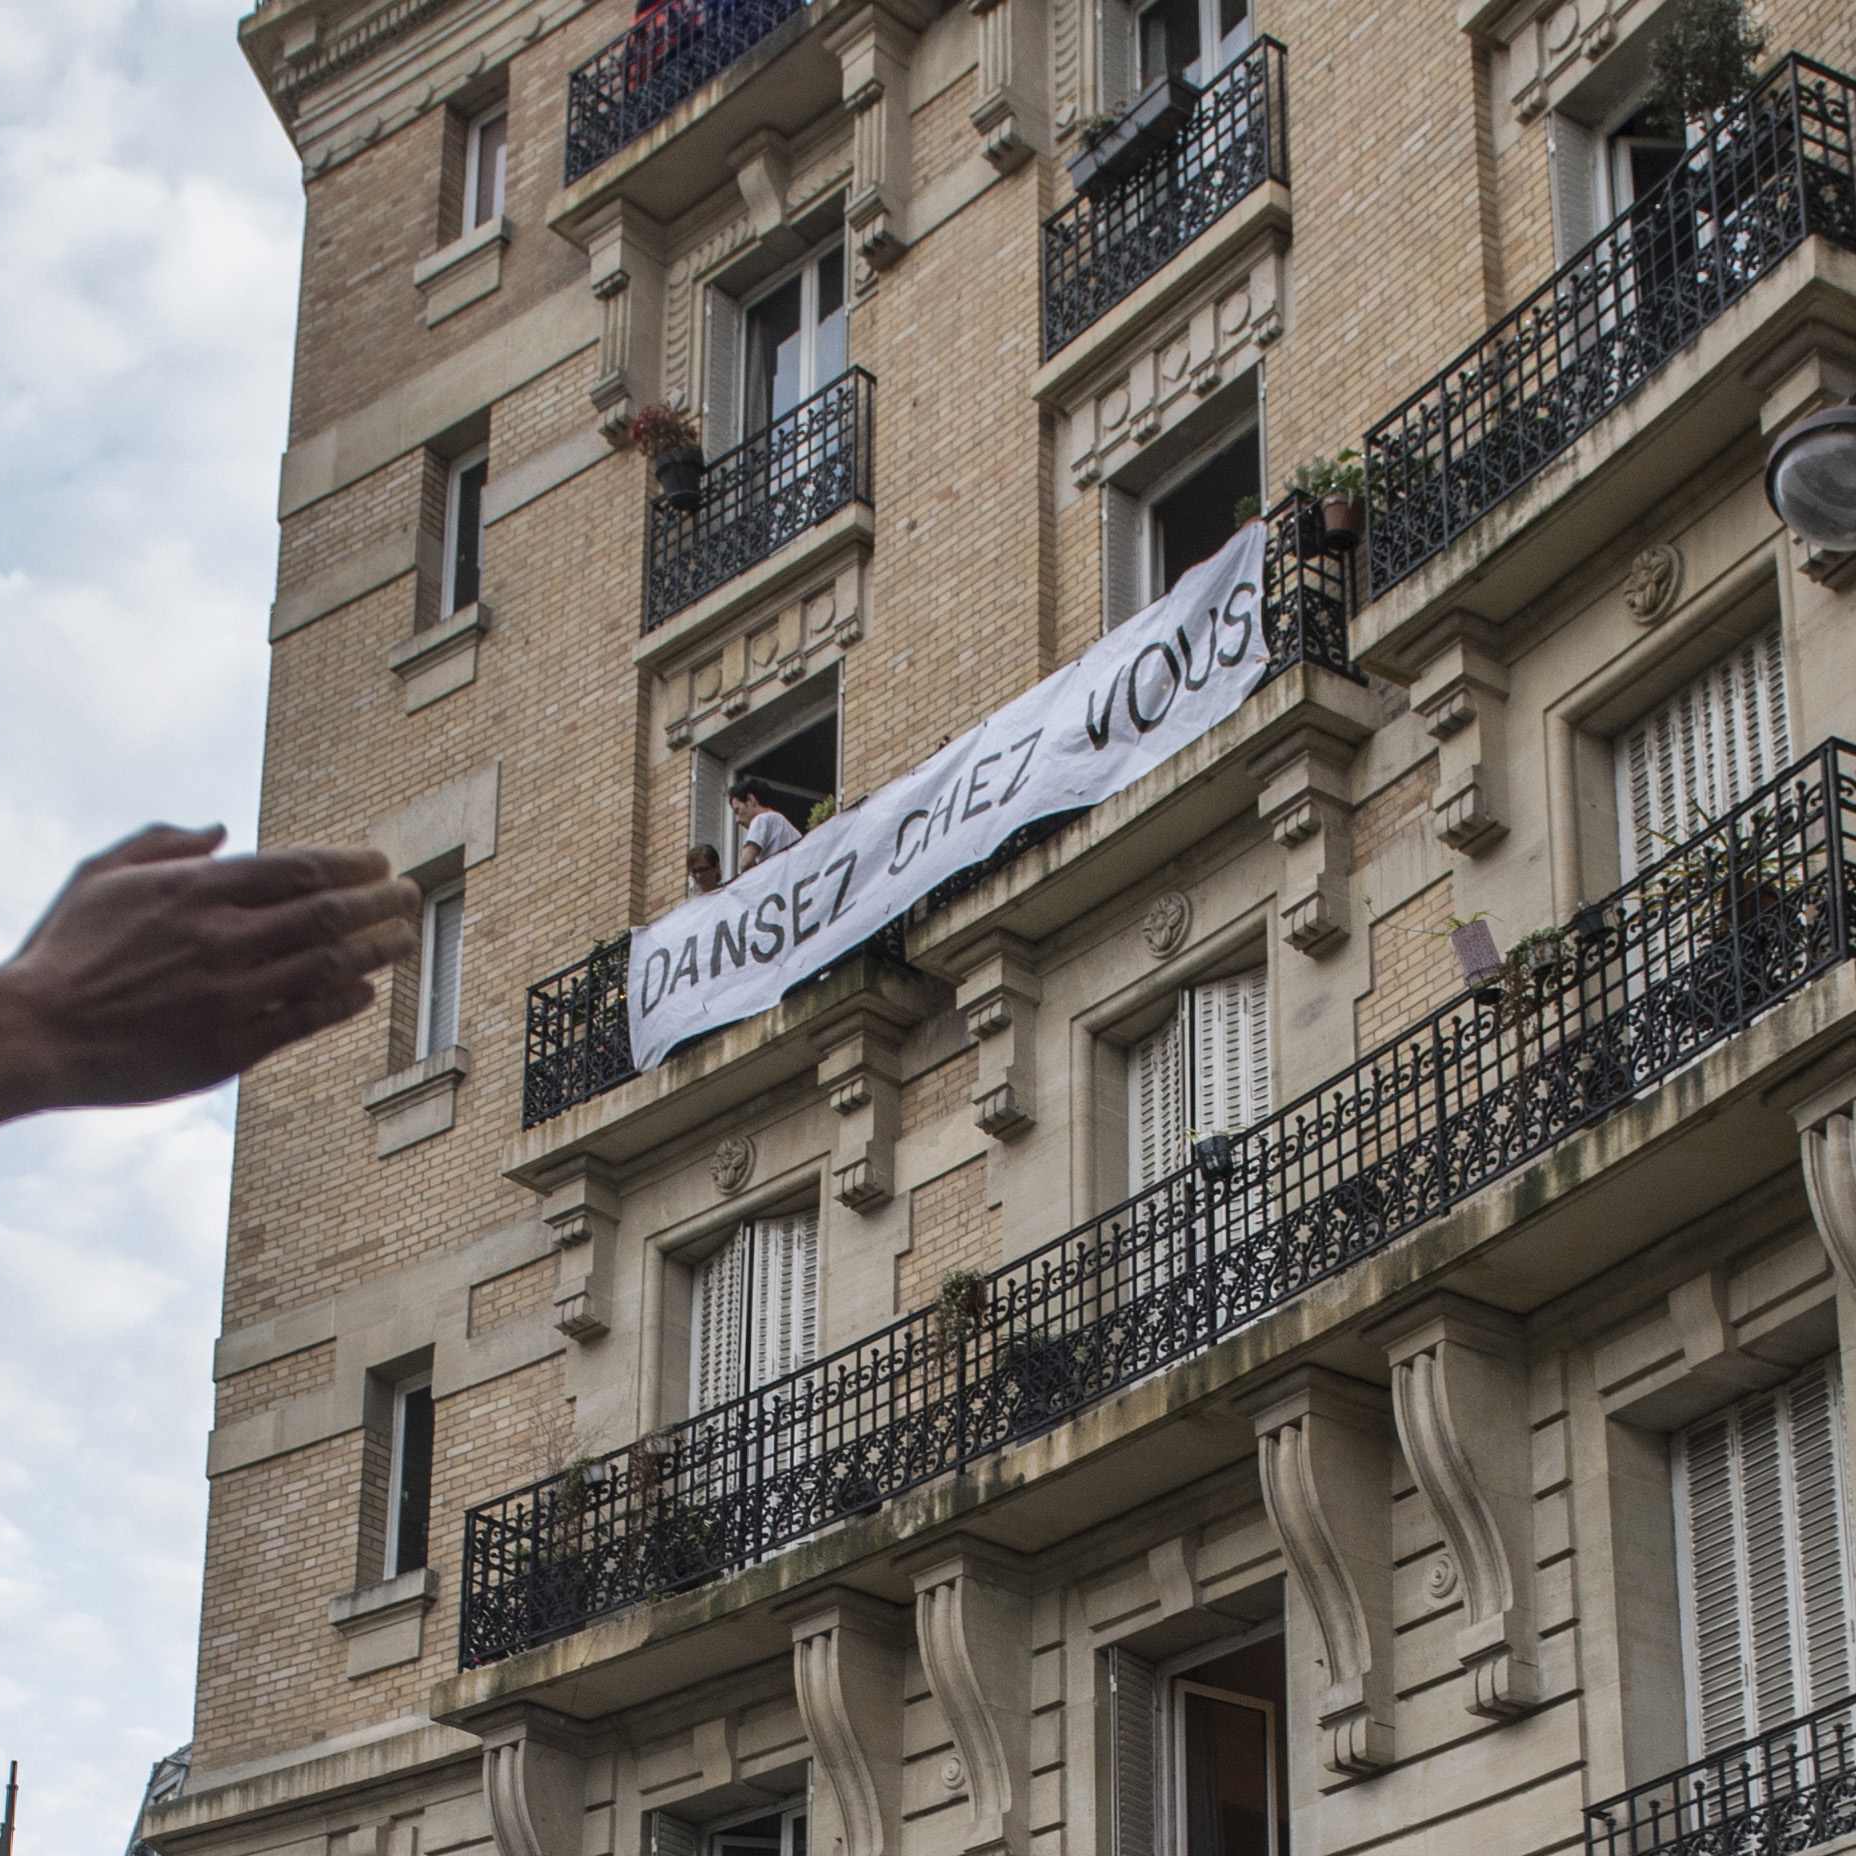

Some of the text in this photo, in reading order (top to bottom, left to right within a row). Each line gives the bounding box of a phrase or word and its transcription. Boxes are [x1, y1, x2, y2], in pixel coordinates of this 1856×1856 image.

[639, 581, 1256, 1018] DANSEZ CHEZ VOUS
